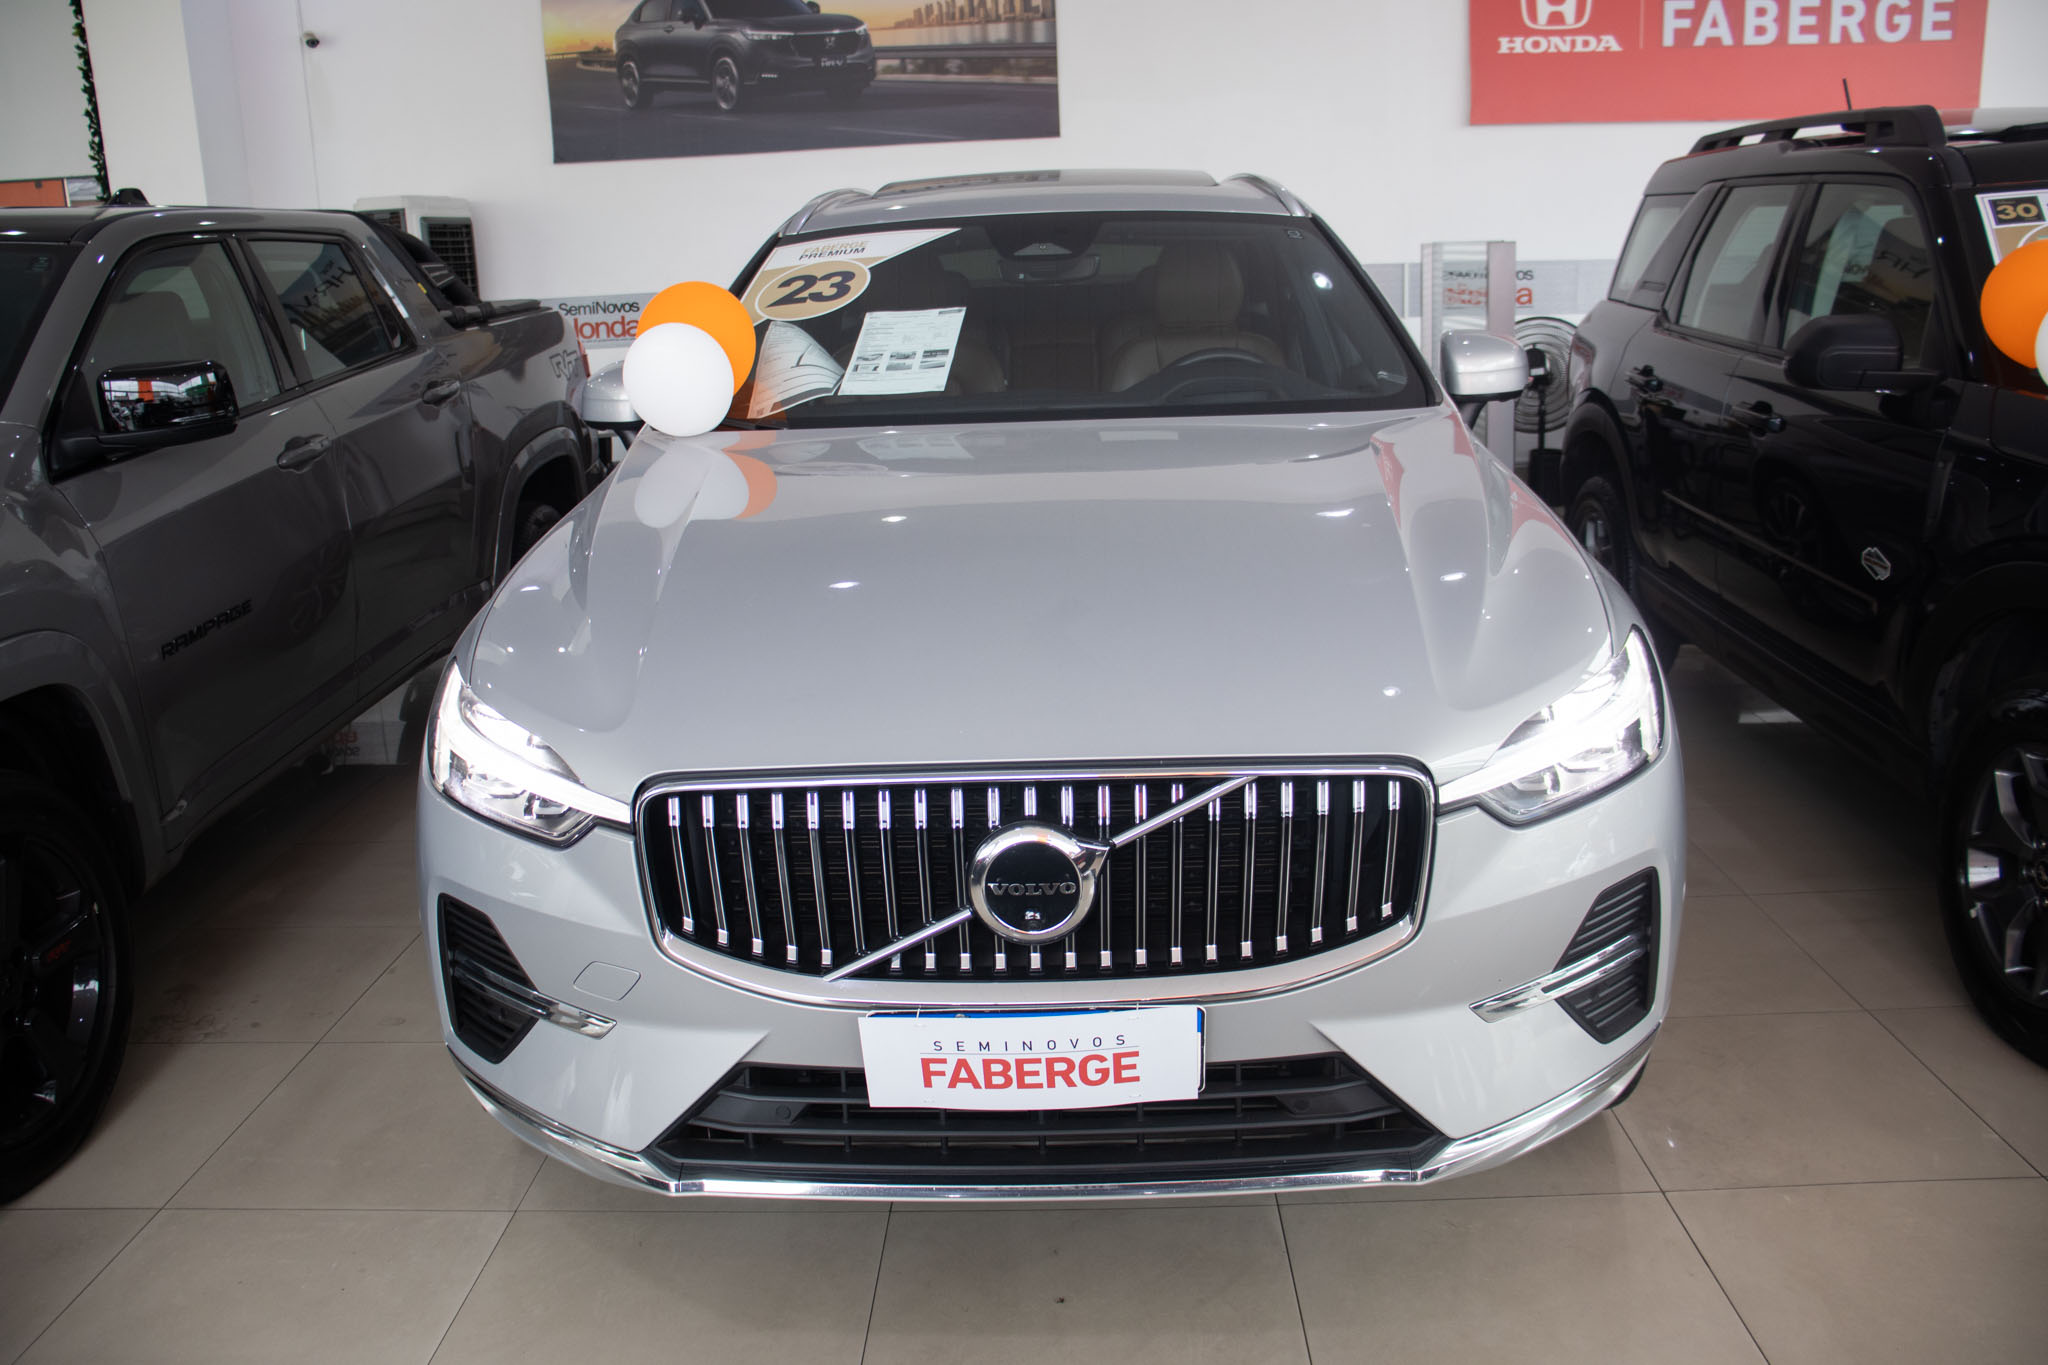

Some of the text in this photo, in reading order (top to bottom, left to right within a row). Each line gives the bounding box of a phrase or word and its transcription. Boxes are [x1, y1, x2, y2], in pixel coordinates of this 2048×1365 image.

[1662, 0, 1953, 47] FABERGE
[1497, 34, 1623, 54] HONDA
[1996, 203, 2039, 219] 30
[799, 247, 866, 260] PREMIUM
[766, 271, 856, 308] 23
[559, 301, 640, 316] SemiNovos
[161, 598, 253, 661] RAMPAGE
[987, 881, 1077, 896] VOLVO
[933, 1034, 1126, 1052] SEMINOVOS
[920, 1050, 1141, 1090] FABERGE
